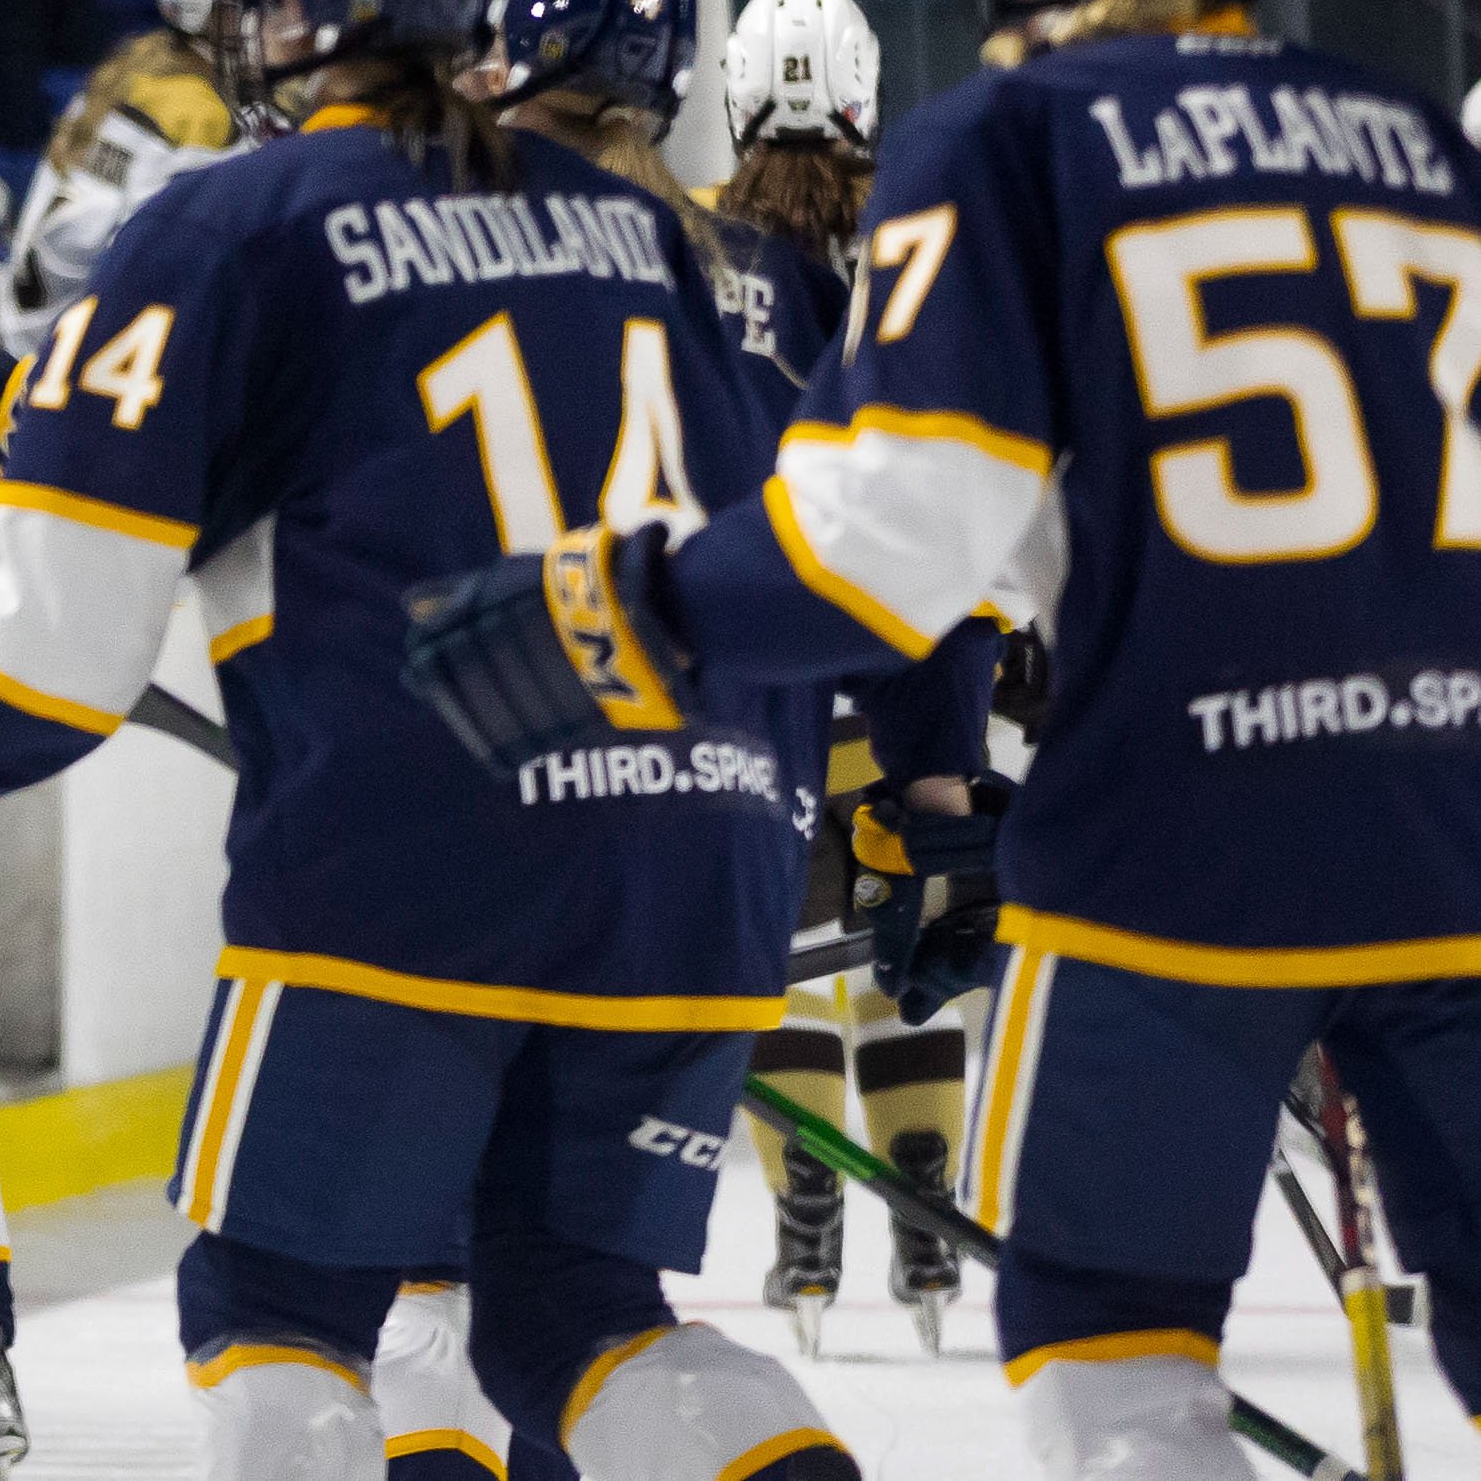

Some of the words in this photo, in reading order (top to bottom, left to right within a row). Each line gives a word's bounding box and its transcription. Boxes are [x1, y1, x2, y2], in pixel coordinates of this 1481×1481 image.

[782, 54, 814, 83] 21
[325, 193, 676, 305] SANDILAND
[846, 200, 959, 357] 7
[28, 294, 177, 431] 14
[414, 309, 711, 556] 14
[627, 1115, 727, 1172] CC
